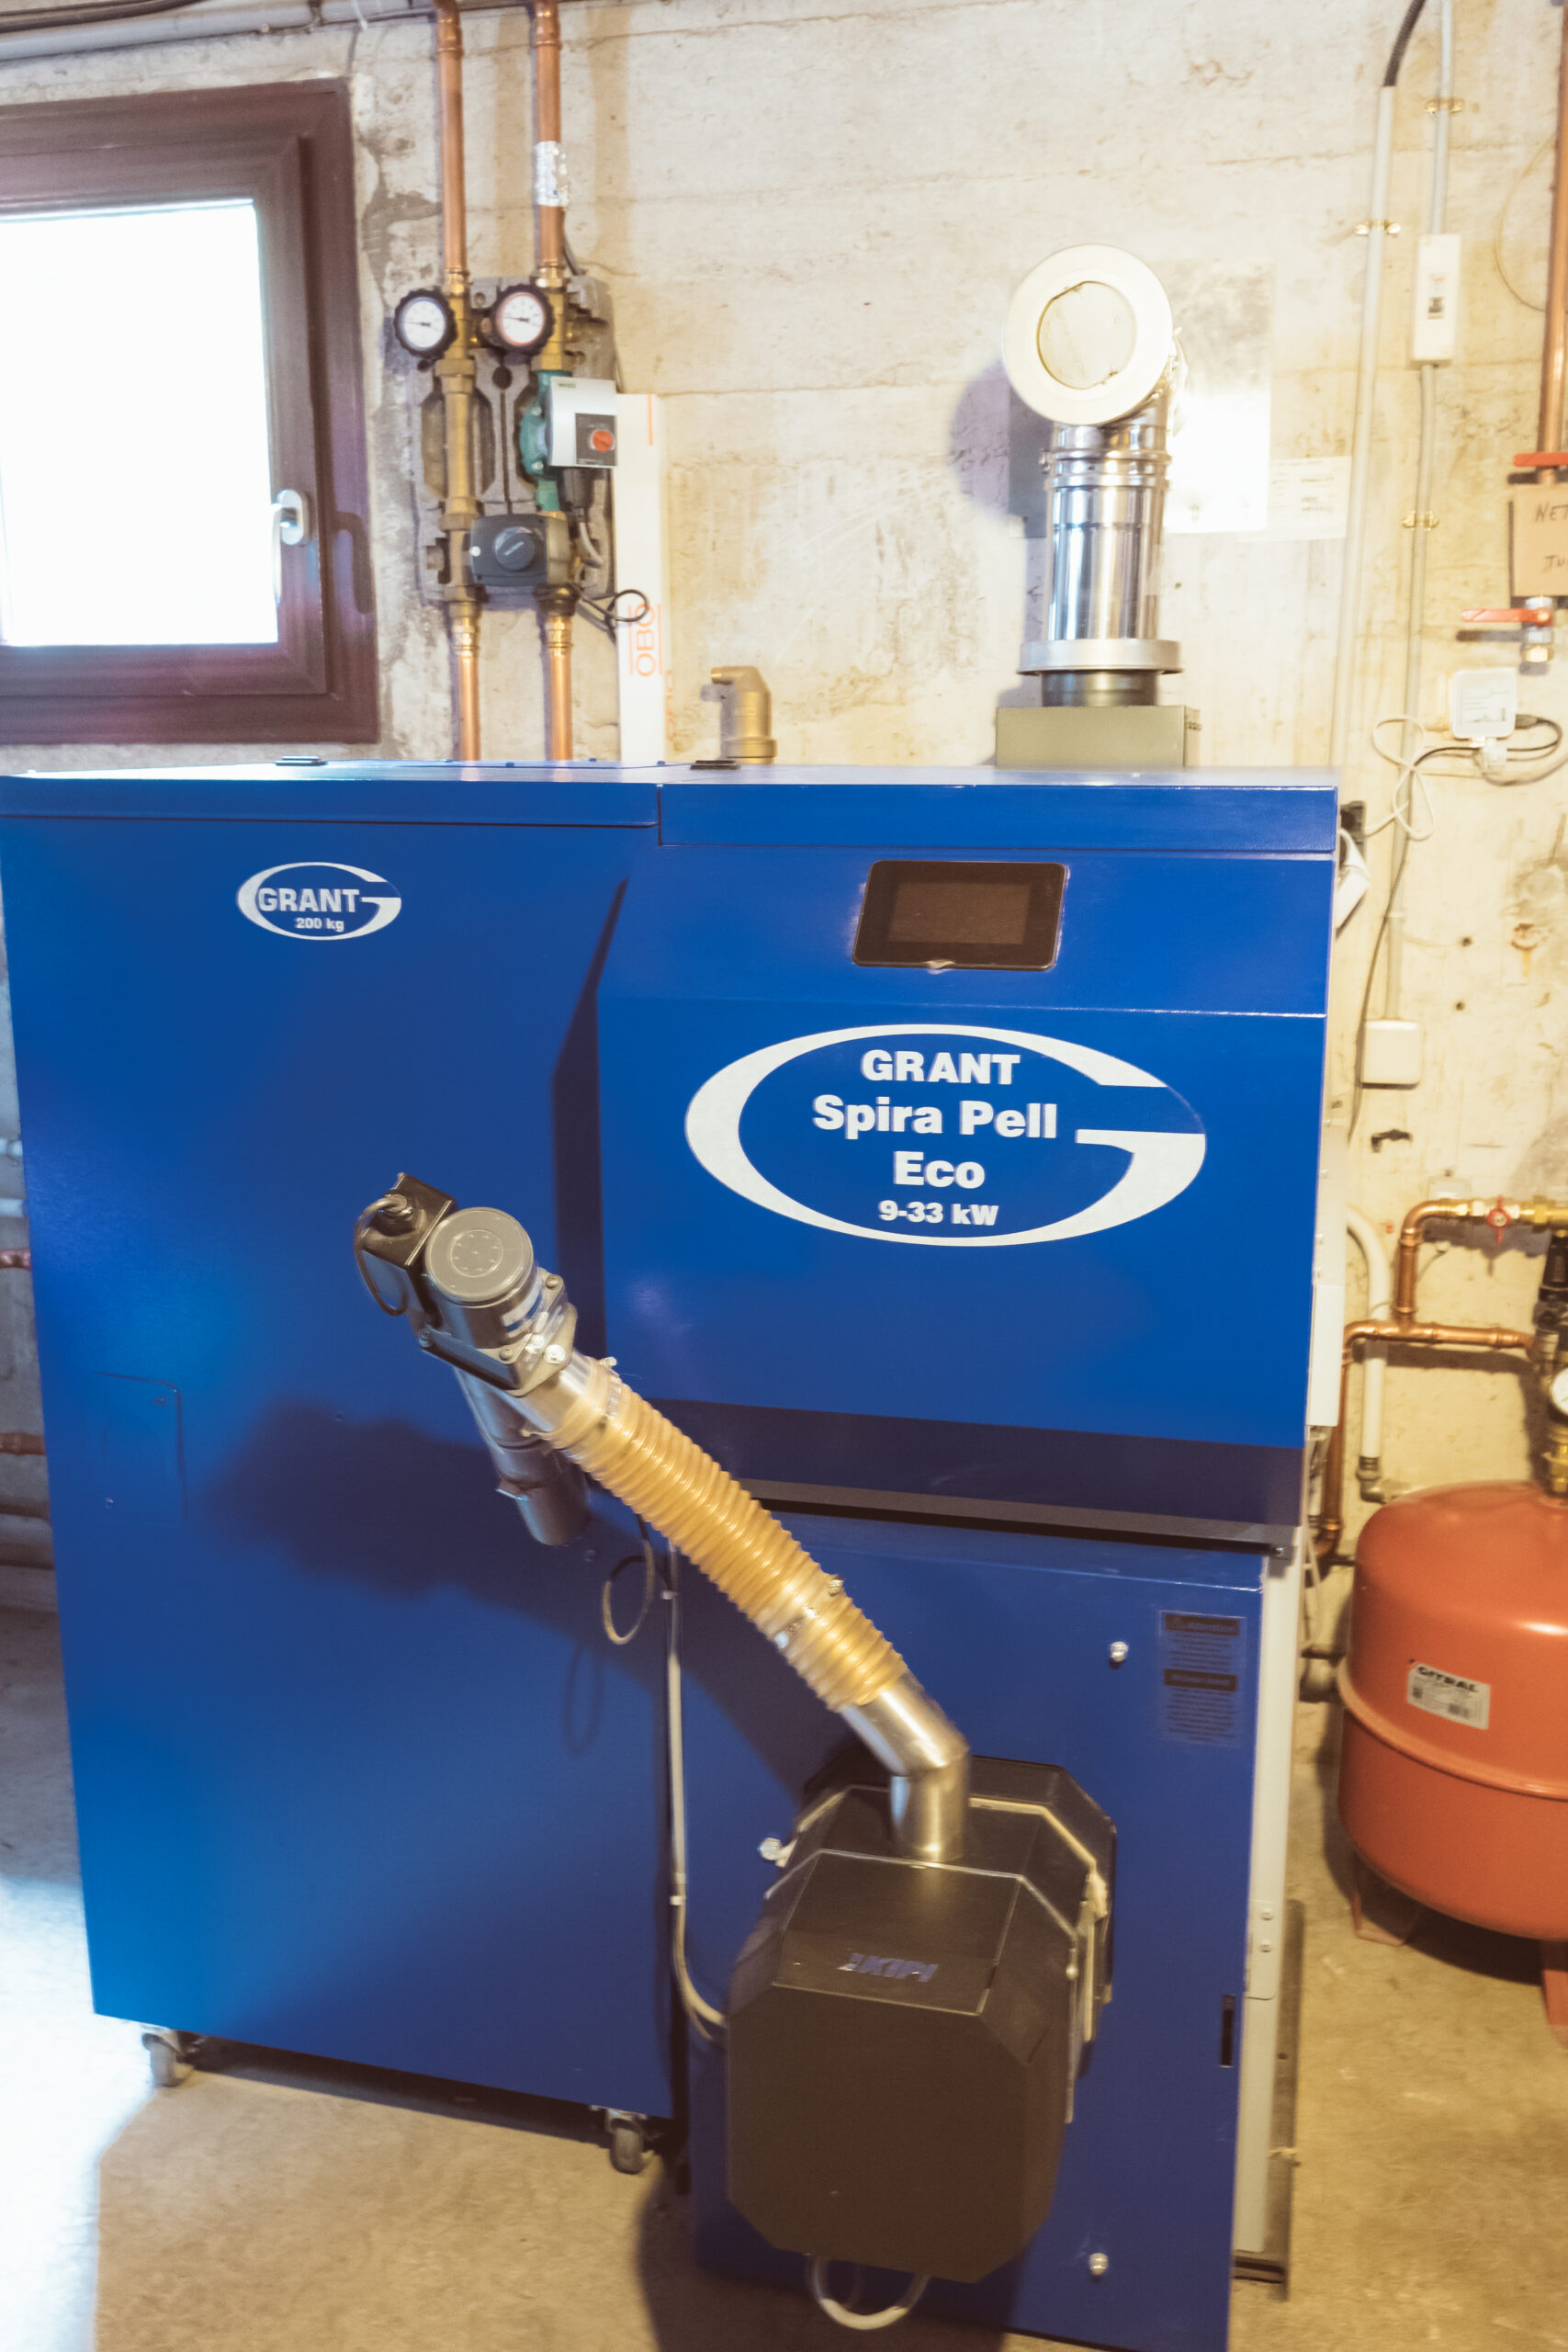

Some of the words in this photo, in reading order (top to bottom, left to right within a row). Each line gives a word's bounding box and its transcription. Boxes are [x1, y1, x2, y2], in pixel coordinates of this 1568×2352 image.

[635, 603, 656, 677] OBO
[258, 888, 359, 912] GRANT
[296, 917, 322, 929] 200
[326, 918, 344, 933] kg
[862, 1049, 1020, 1084] GRANT
[813, 1095, 942, 1139] Spira
[960, 1101, 1057, 1138] Pell
[894, 1151, 985, 1188] Eco
[879, 1201, 943, 1224] 9-33
[953, 1204, 998, 1226] kW
